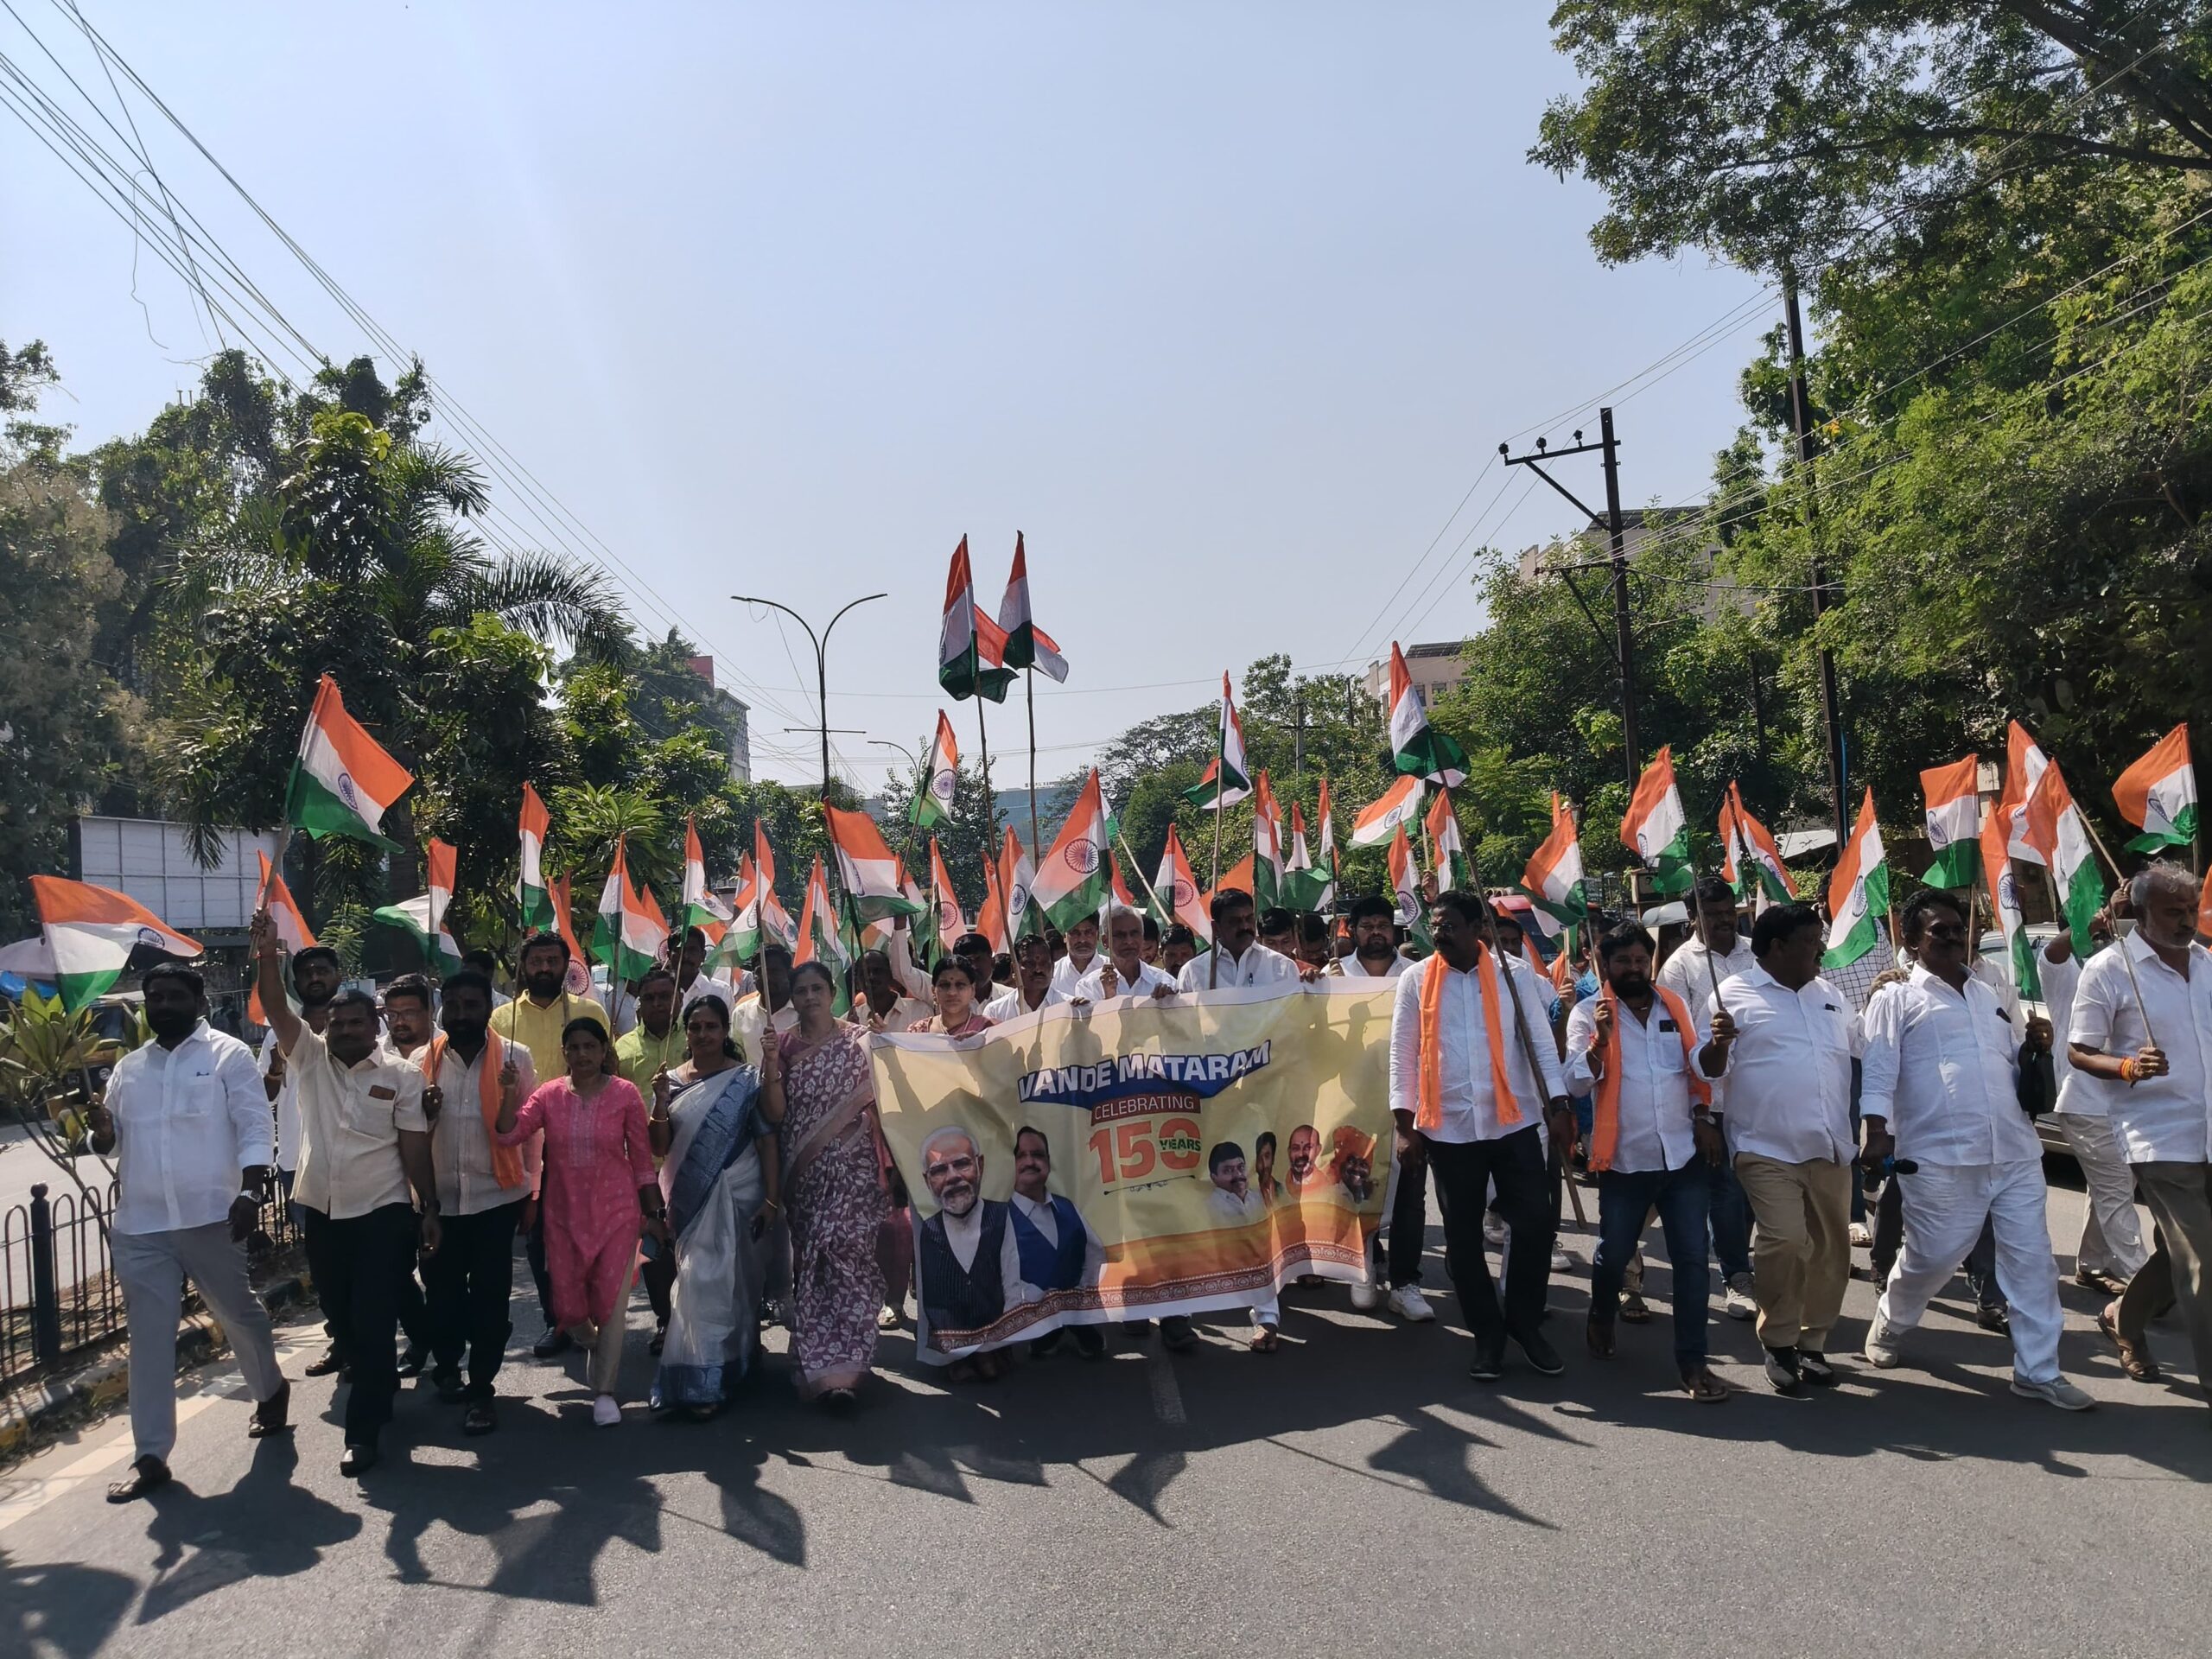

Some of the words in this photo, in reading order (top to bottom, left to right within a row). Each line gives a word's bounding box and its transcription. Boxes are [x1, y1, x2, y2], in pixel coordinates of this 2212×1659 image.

[1019, 1060, 1112, 1102] VANDE
[1118, 1040, 1271, 1083] MATARAM
[1094, 1096, 1195, 1121] CELEBRATING
[1089, 1118, 1201, 1184] 150
[1159, 1137, 1202, 1152] YEARS
